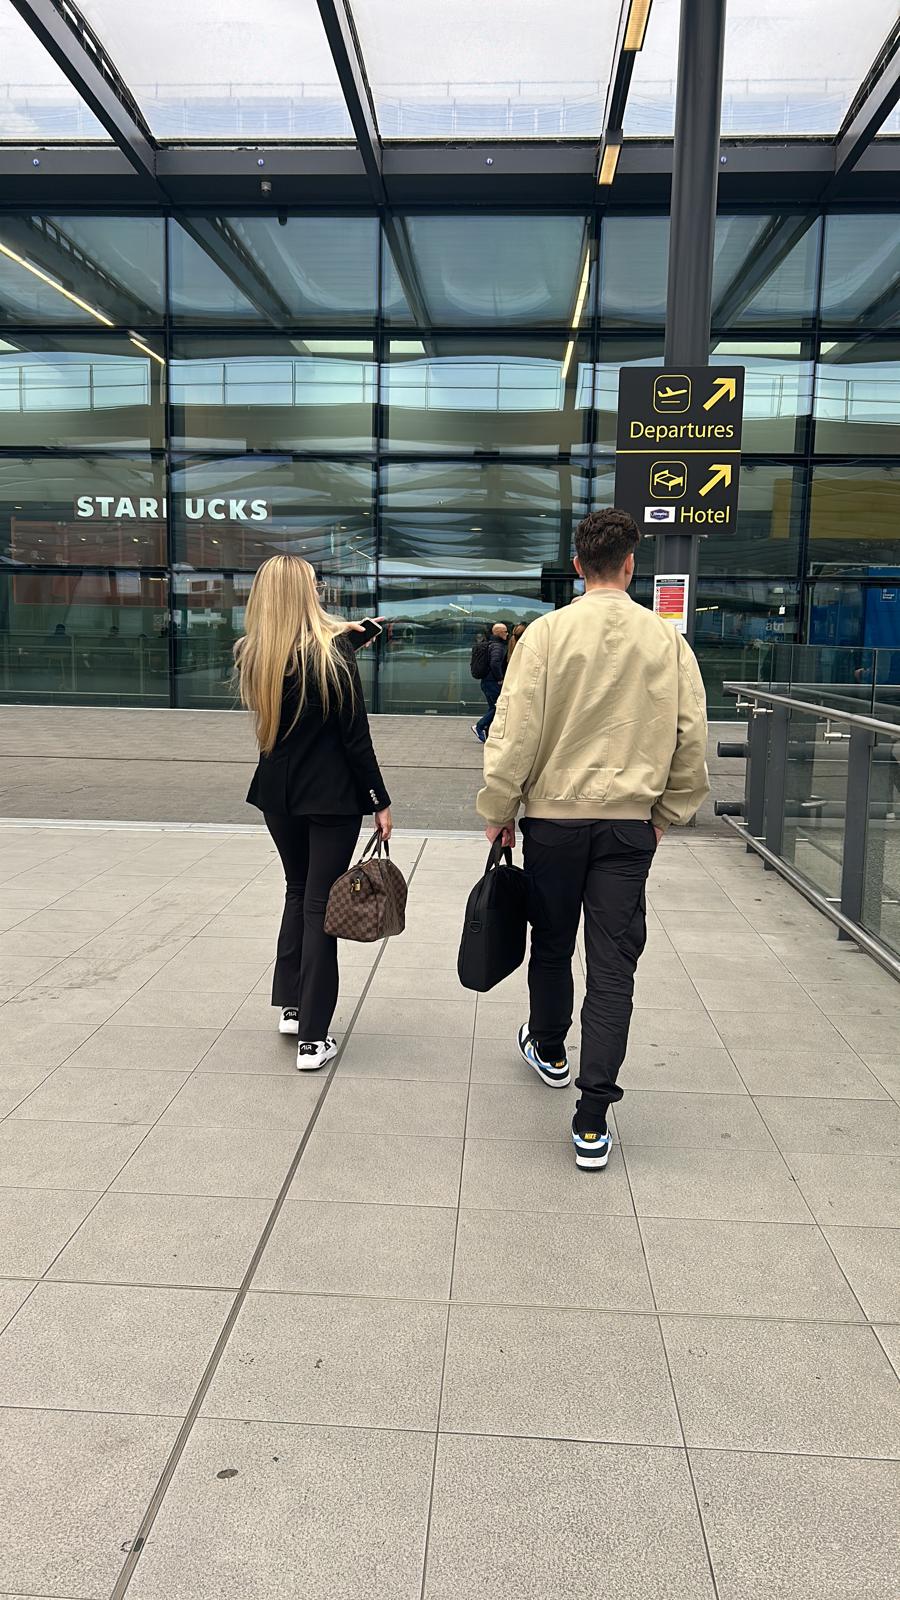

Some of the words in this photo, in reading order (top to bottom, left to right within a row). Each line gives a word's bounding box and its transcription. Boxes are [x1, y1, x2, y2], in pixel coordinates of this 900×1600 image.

[630, 421, 734, 442] Departures
[77, 496, 268, 520] STARUCKS
[680, 505, 730, 523] Hotel
[584, 1132, 598, 1140] NIKE
